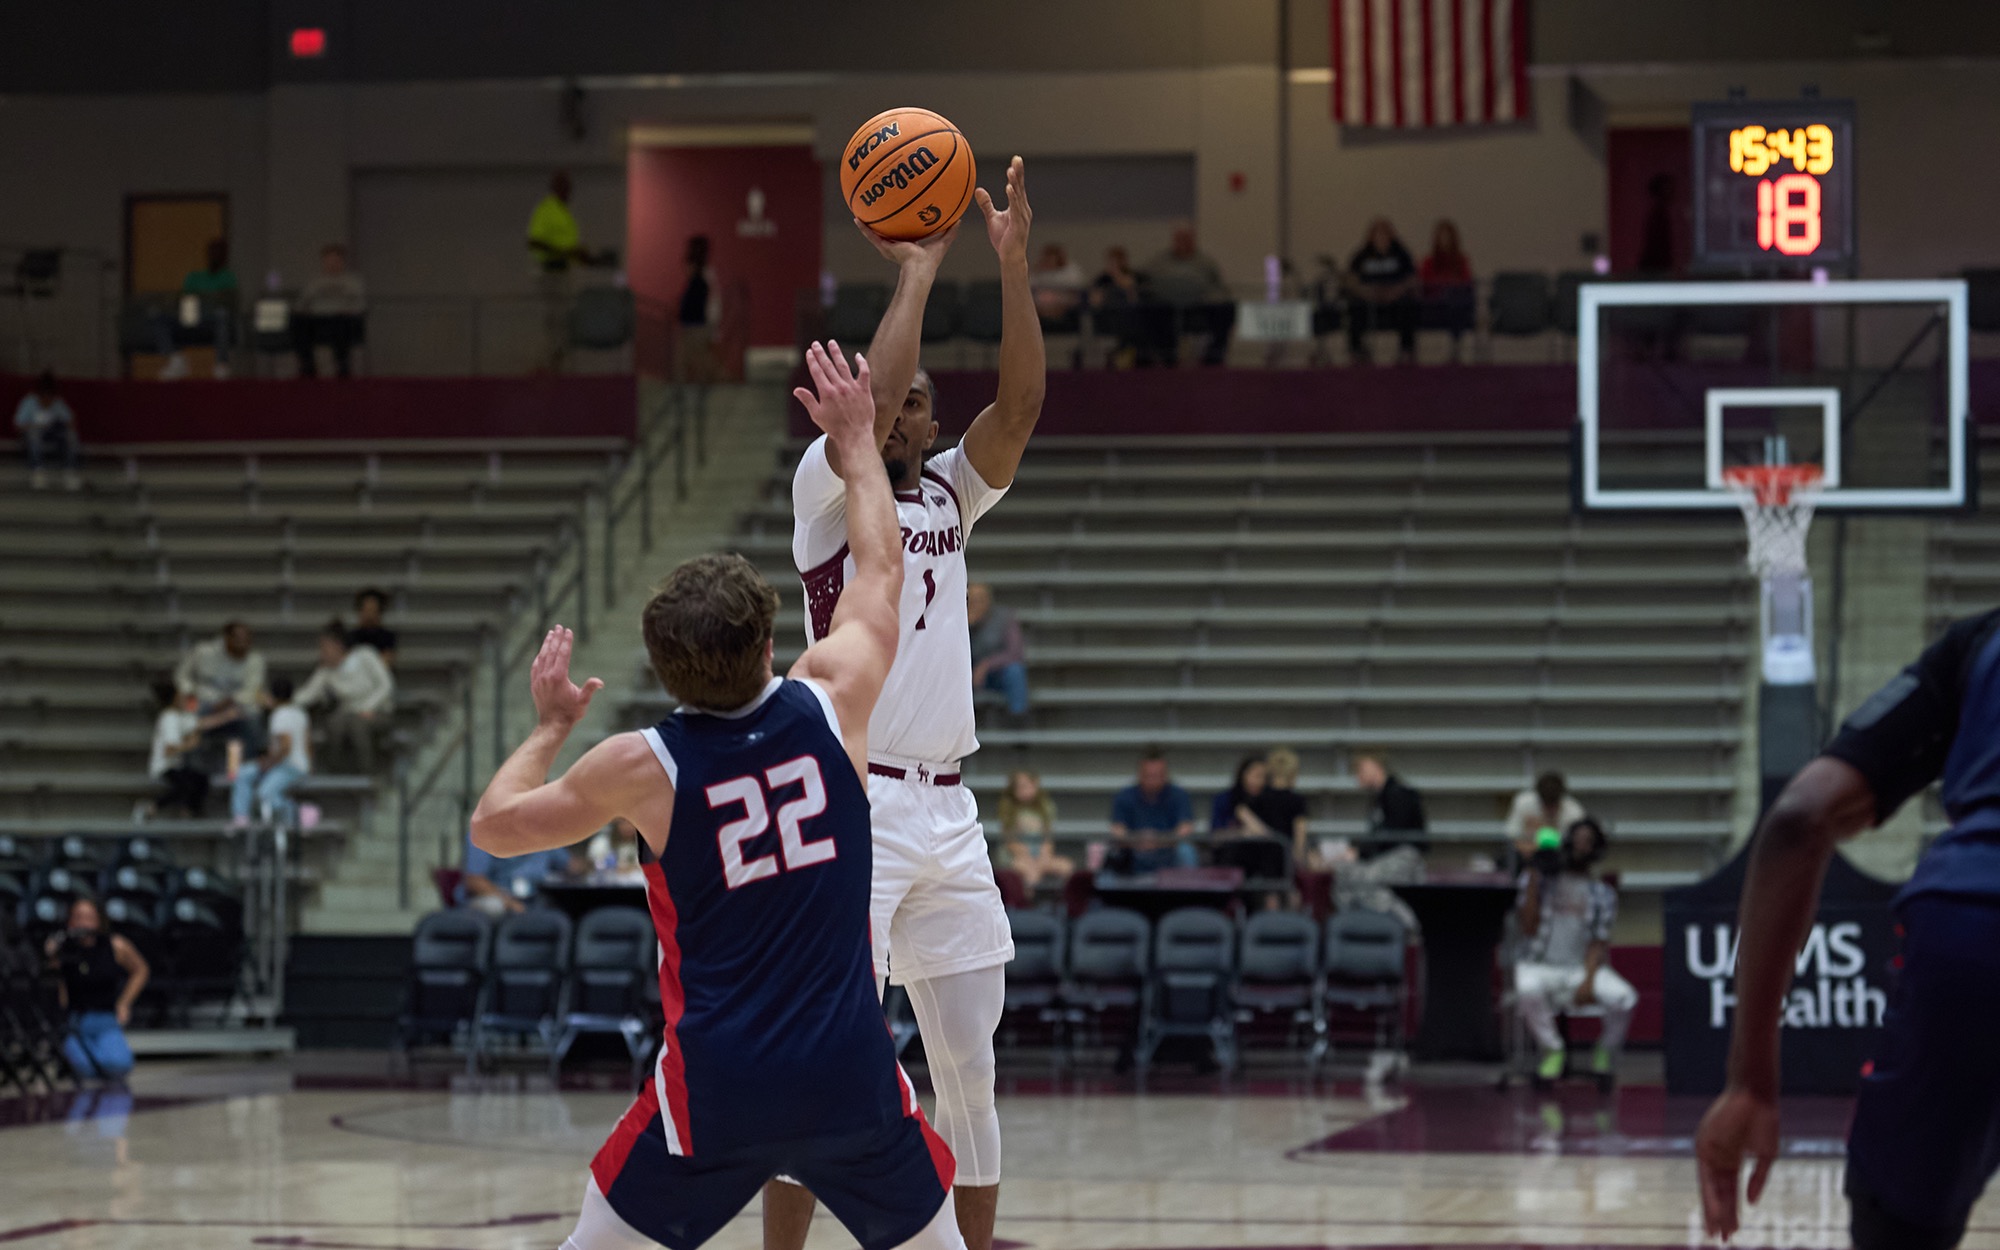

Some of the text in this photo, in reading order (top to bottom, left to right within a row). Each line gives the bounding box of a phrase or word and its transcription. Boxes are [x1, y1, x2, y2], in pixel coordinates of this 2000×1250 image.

[848, 121, 901, 172] NCAA
[1729, 124, 1834, 176] 15:43
[860, 146, 940, 207] Wilson
[1757, 173, 1822, 256] 18
[915, 568, 936, 631] 1
[704, 754, 837, 891] 22
[1685, 921, 1866, 979] UMS
[1710, 976, 1888, 1029] Halth
